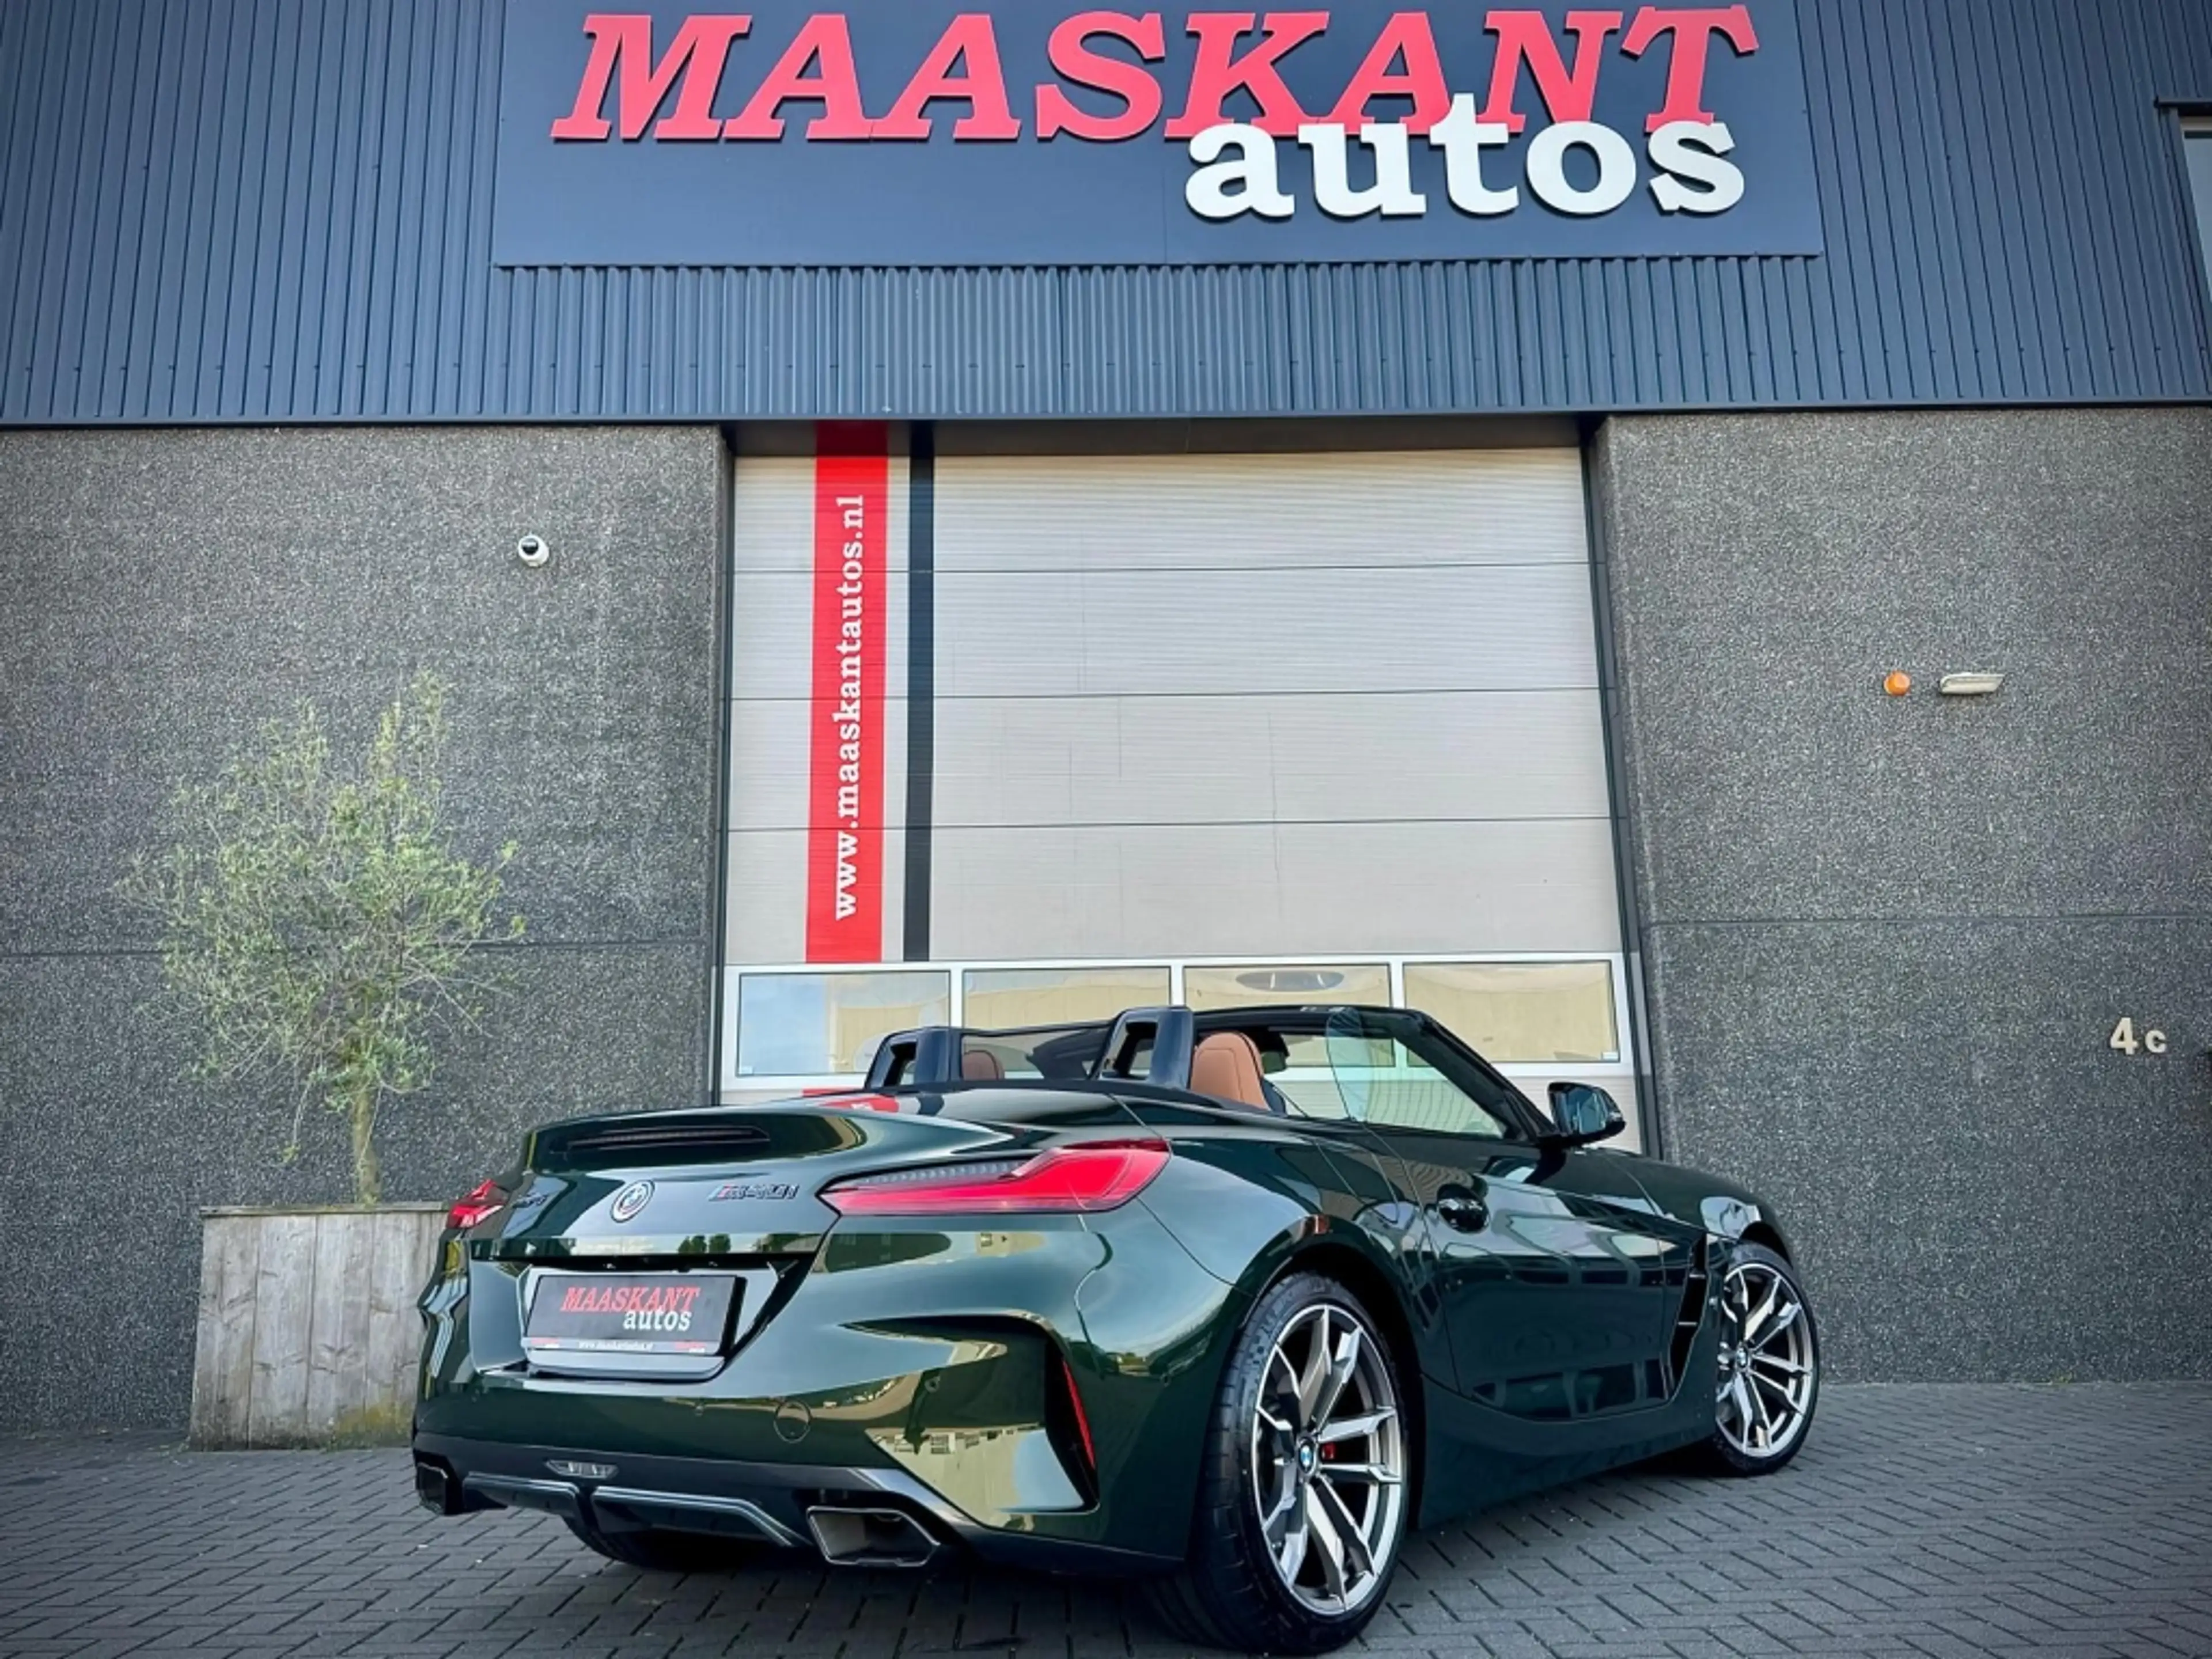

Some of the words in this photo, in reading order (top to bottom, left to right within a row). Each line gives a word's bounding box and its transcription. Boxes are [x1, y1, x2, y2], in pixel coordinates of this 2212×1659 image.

[552, 6, 1757, 142] MAASKANT
[1185, 93, 1747, 219] autos
[832, 494, 865, 921] www.maaskantautos.nl
[560, 1286, 700, 1312] MAASKANT
[622, 1305, 692, 1331] autos
